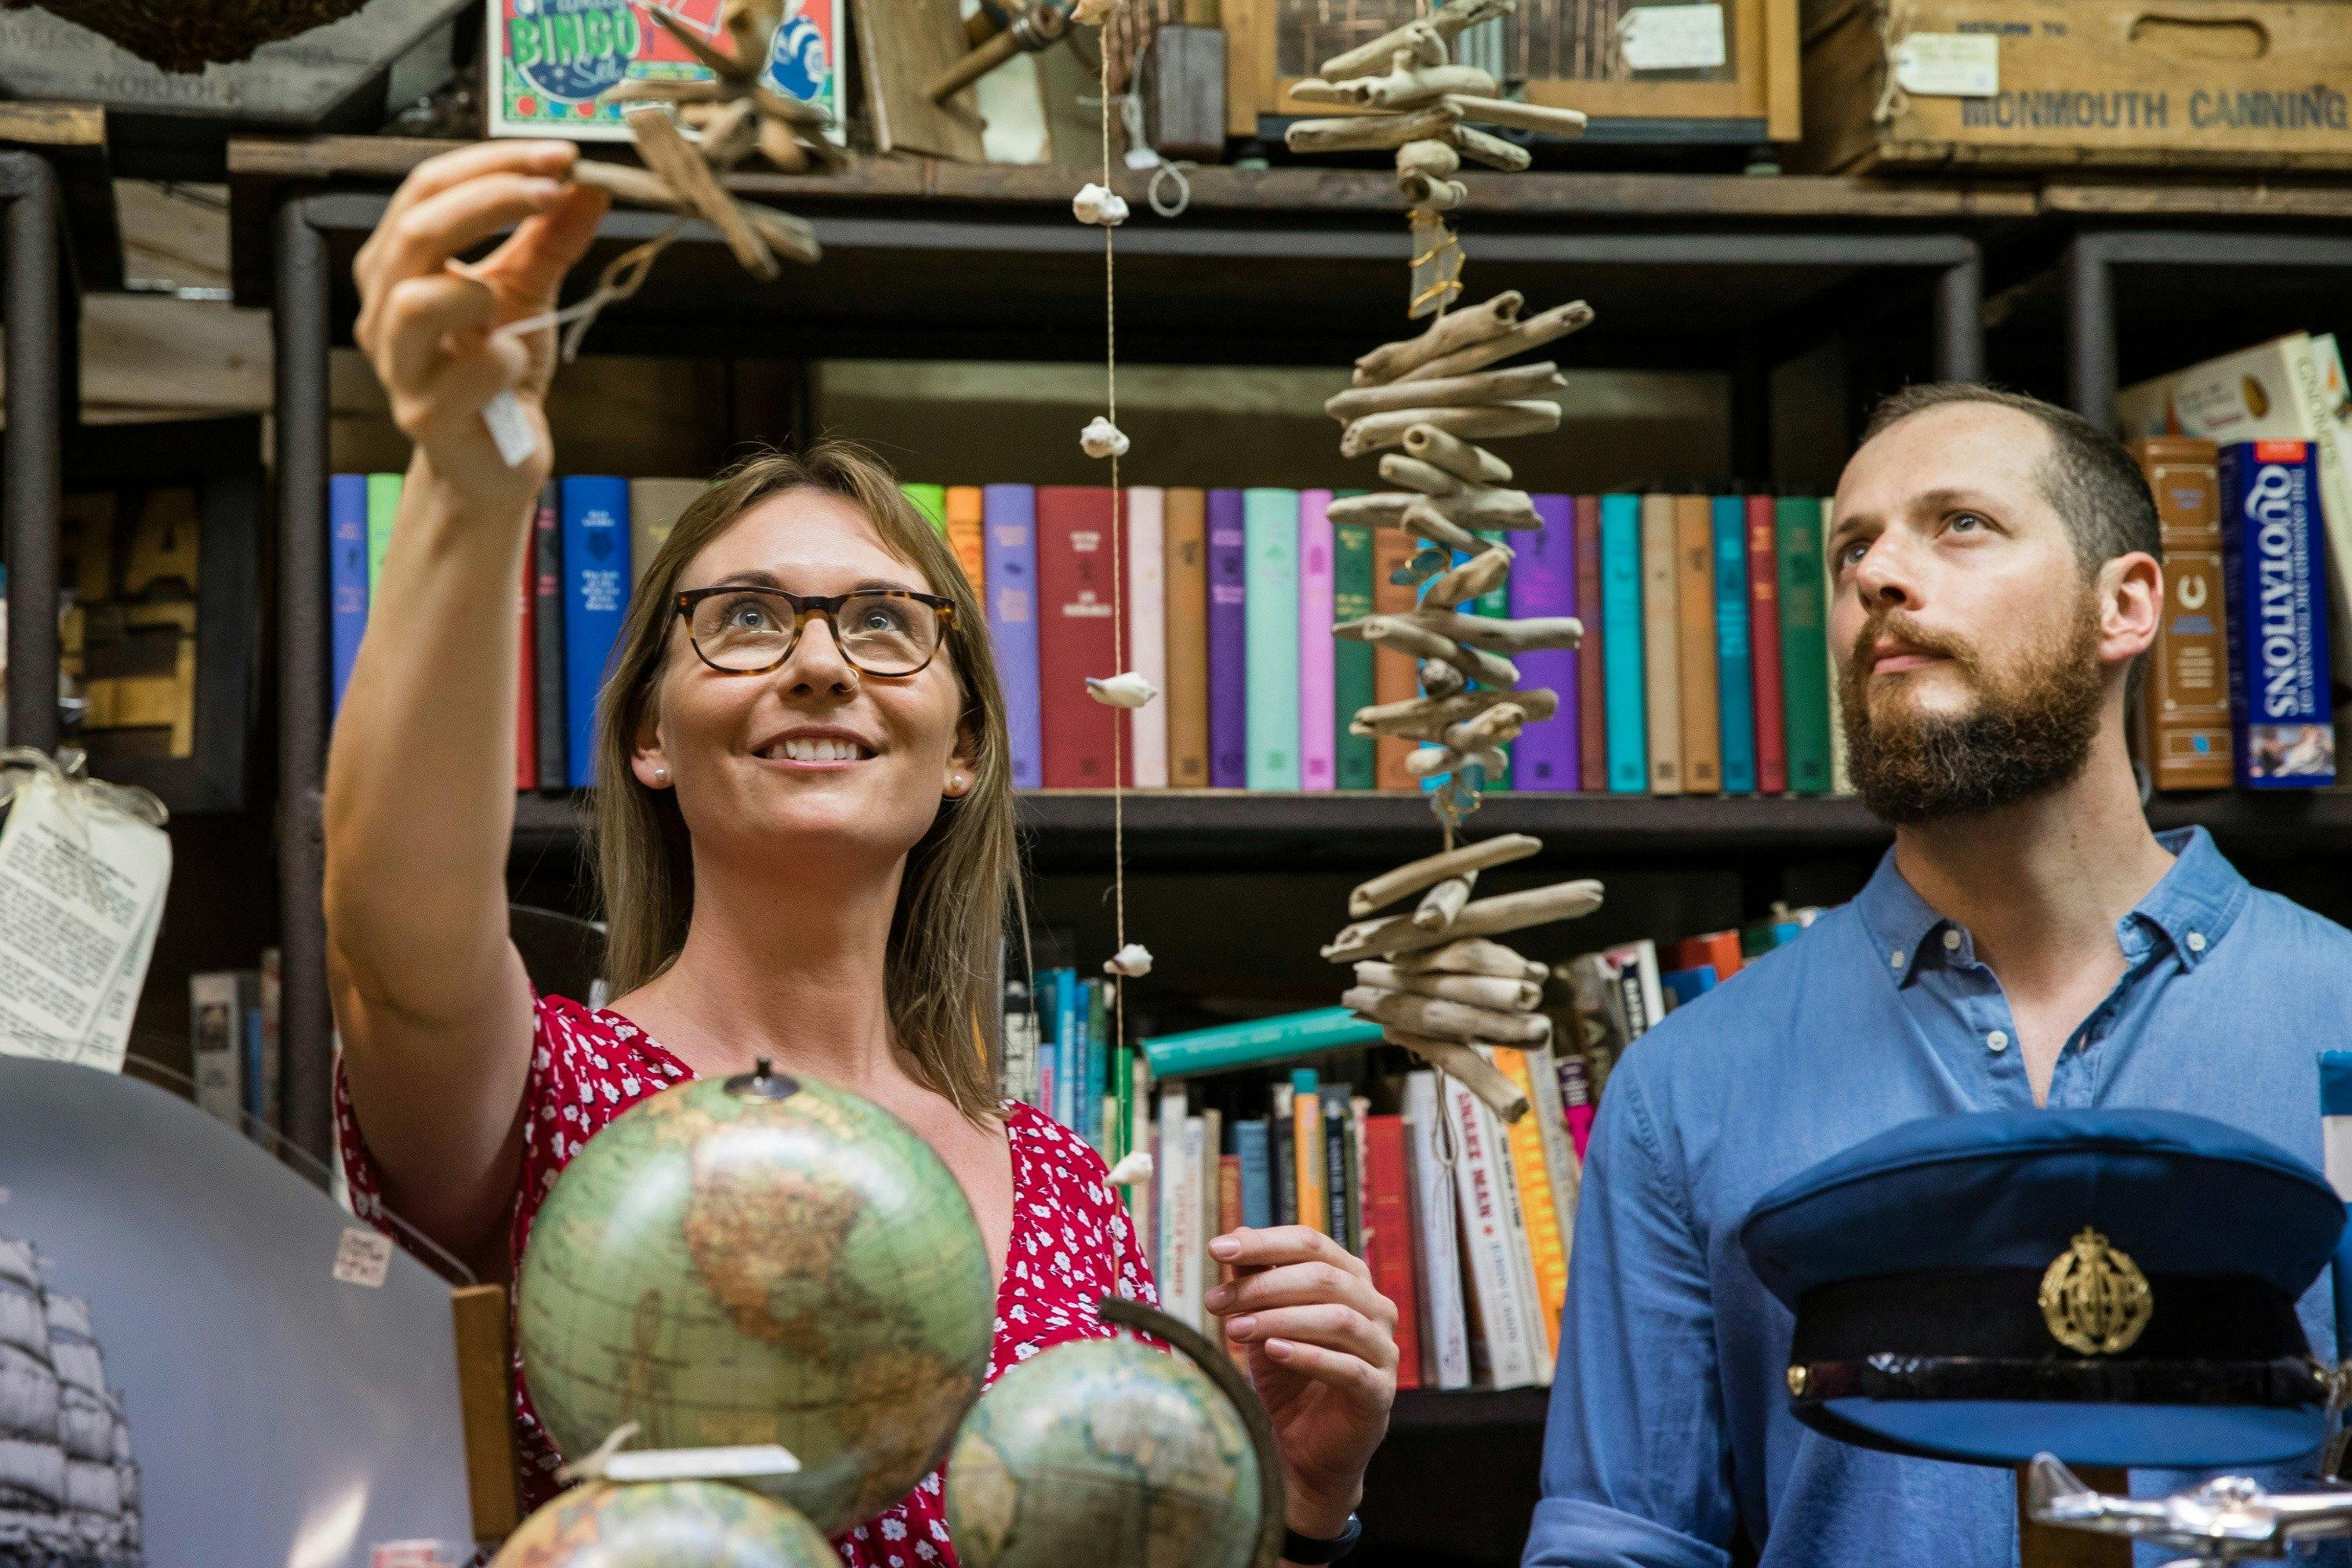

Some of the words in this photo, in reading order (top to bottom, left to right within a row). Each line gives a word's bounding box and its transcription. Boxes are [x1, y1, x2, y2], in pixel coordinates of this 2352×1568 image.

[510, 9, 639, 65] BINGO
[1962, 91, 2169, 129] MONMOUTH
[2188, 91, 2347, 130] CANNING
[2245, 464, 2299, 717] QUOTATIONS
